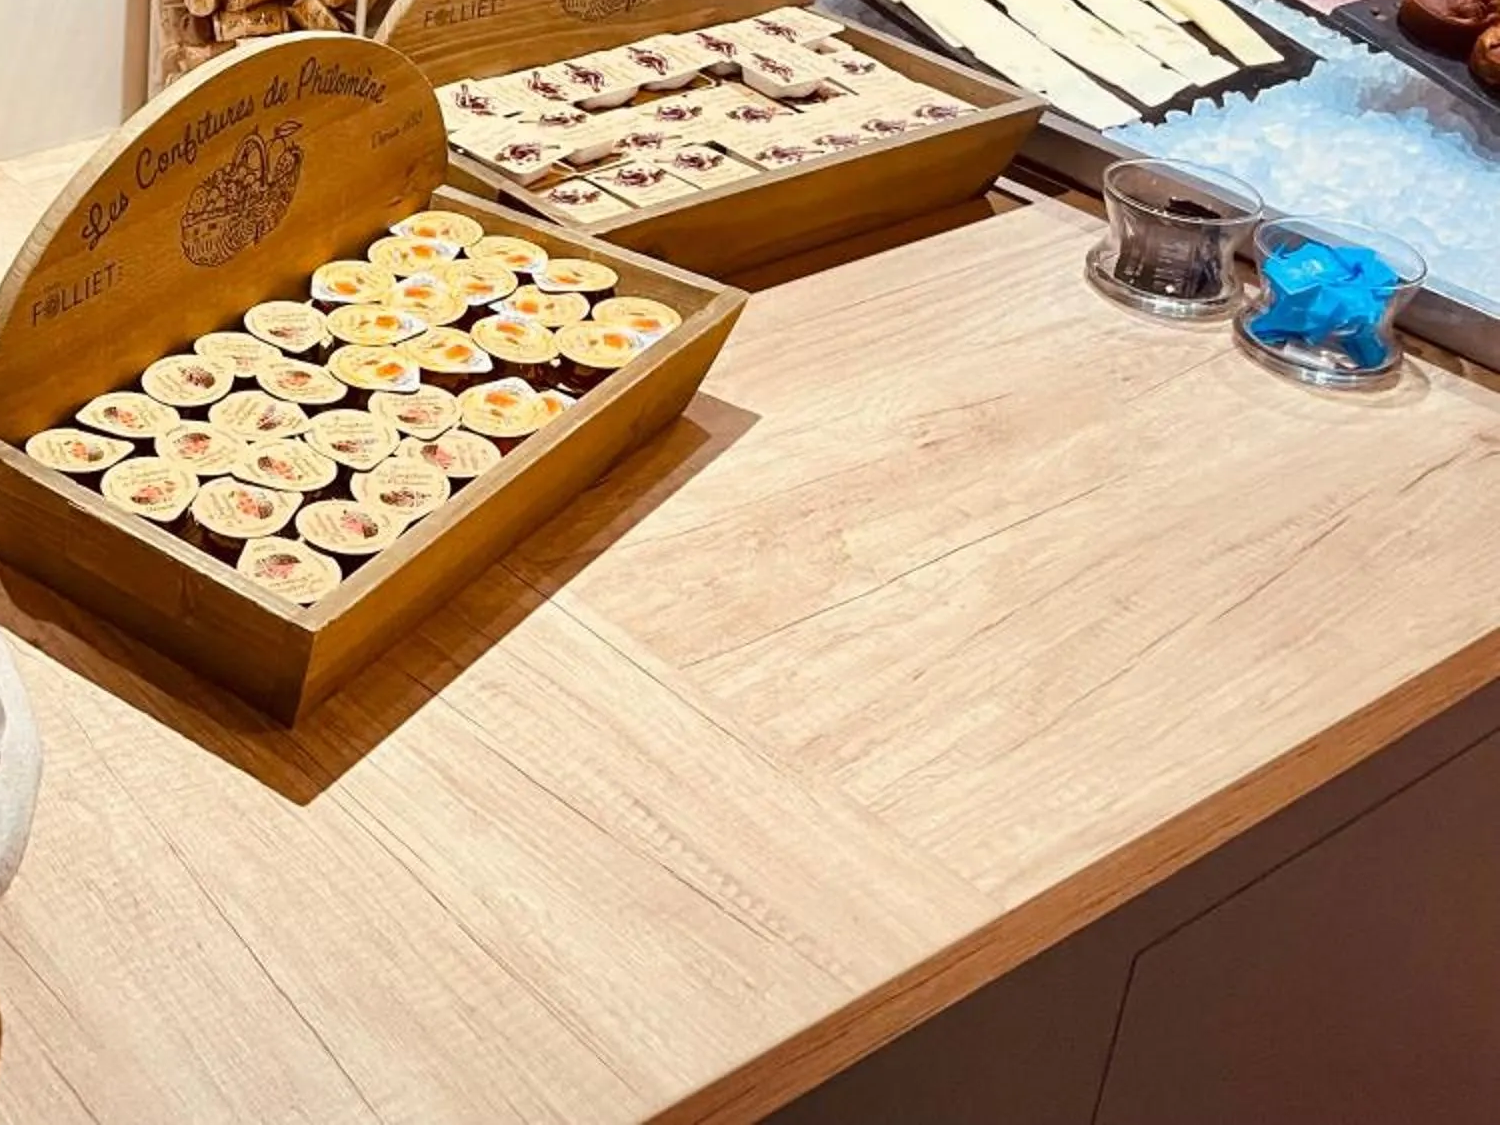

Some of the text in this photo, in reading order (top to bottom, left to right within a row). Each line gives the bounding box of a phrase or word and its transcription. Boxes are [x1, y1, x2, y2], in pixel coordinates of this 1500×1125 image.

[80, 56, 387, 252] Les Confitures de Philomène
